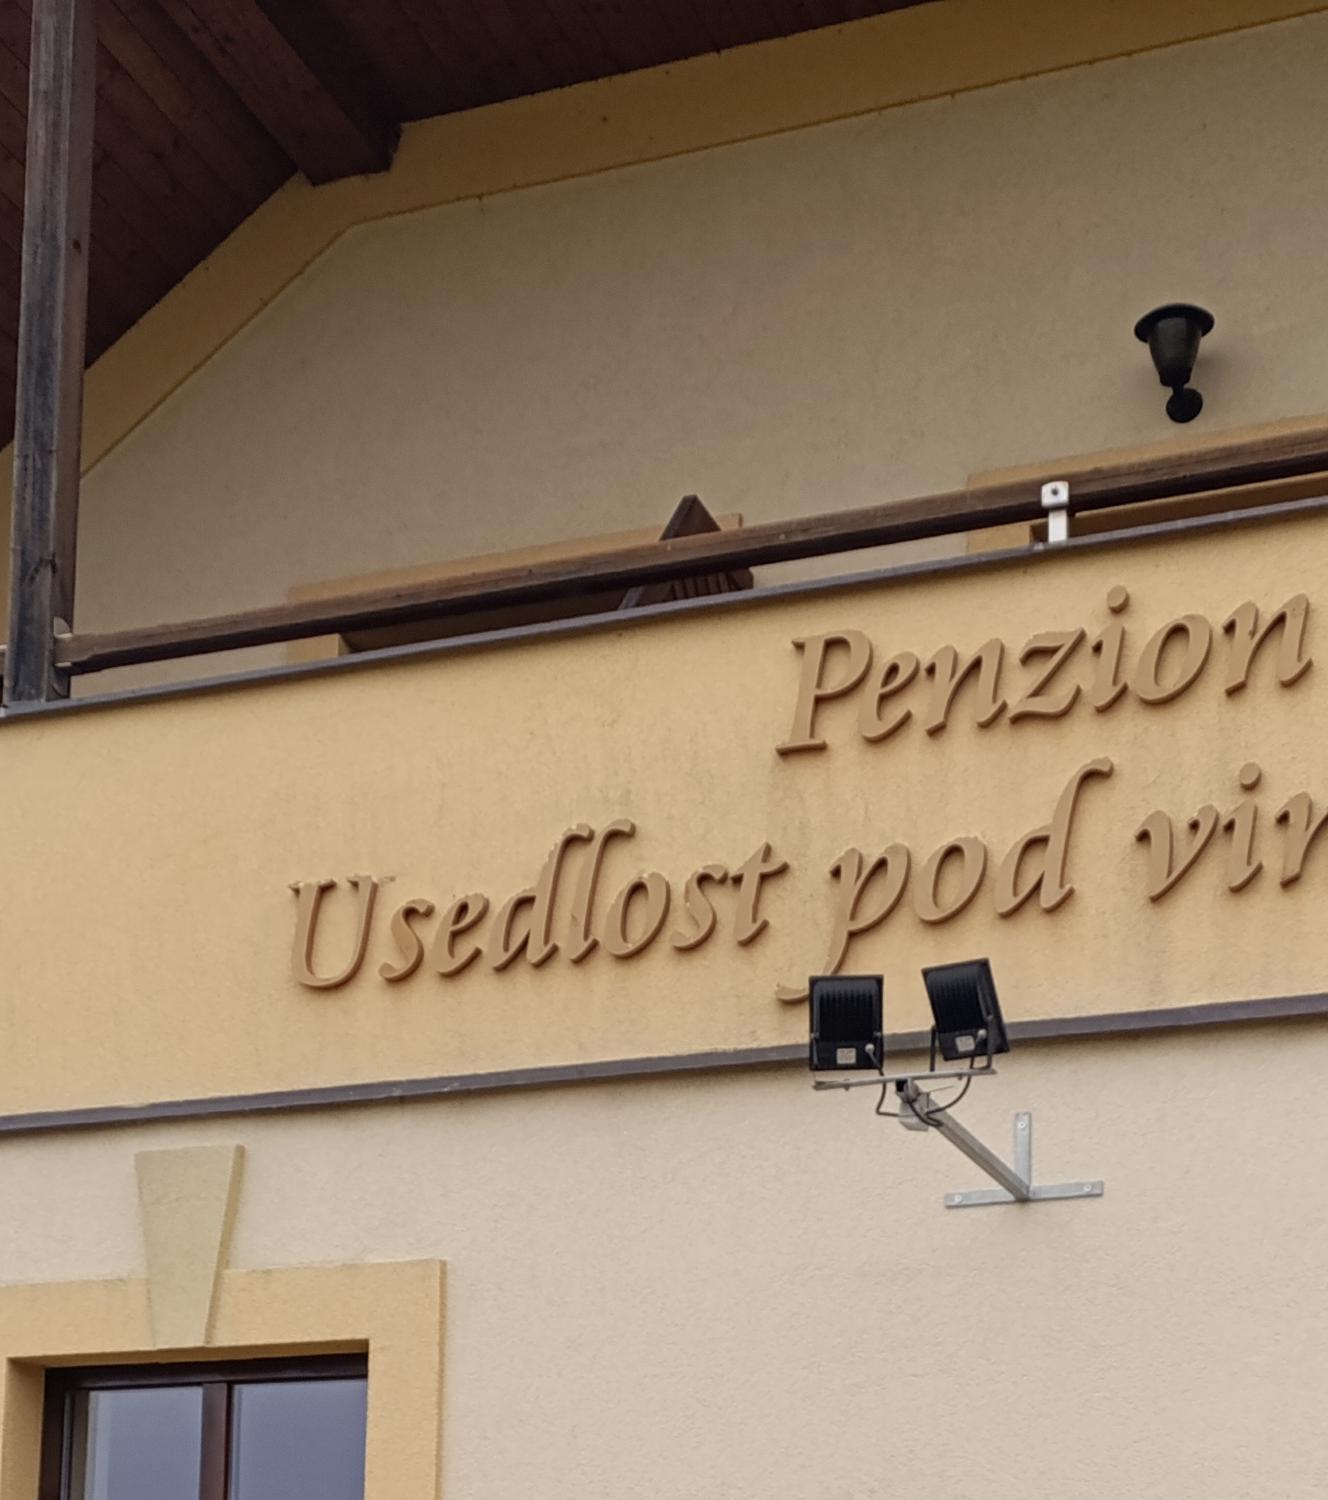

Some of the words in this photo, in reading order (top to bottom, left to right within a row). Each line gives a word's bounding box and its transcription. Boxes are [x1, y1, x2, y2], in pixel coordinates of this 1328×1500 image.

[775, 584, 1314, 758] Penzion
[288, 818, 790, 990] Usedlost
[775, 755, 1115, 1003] pod
